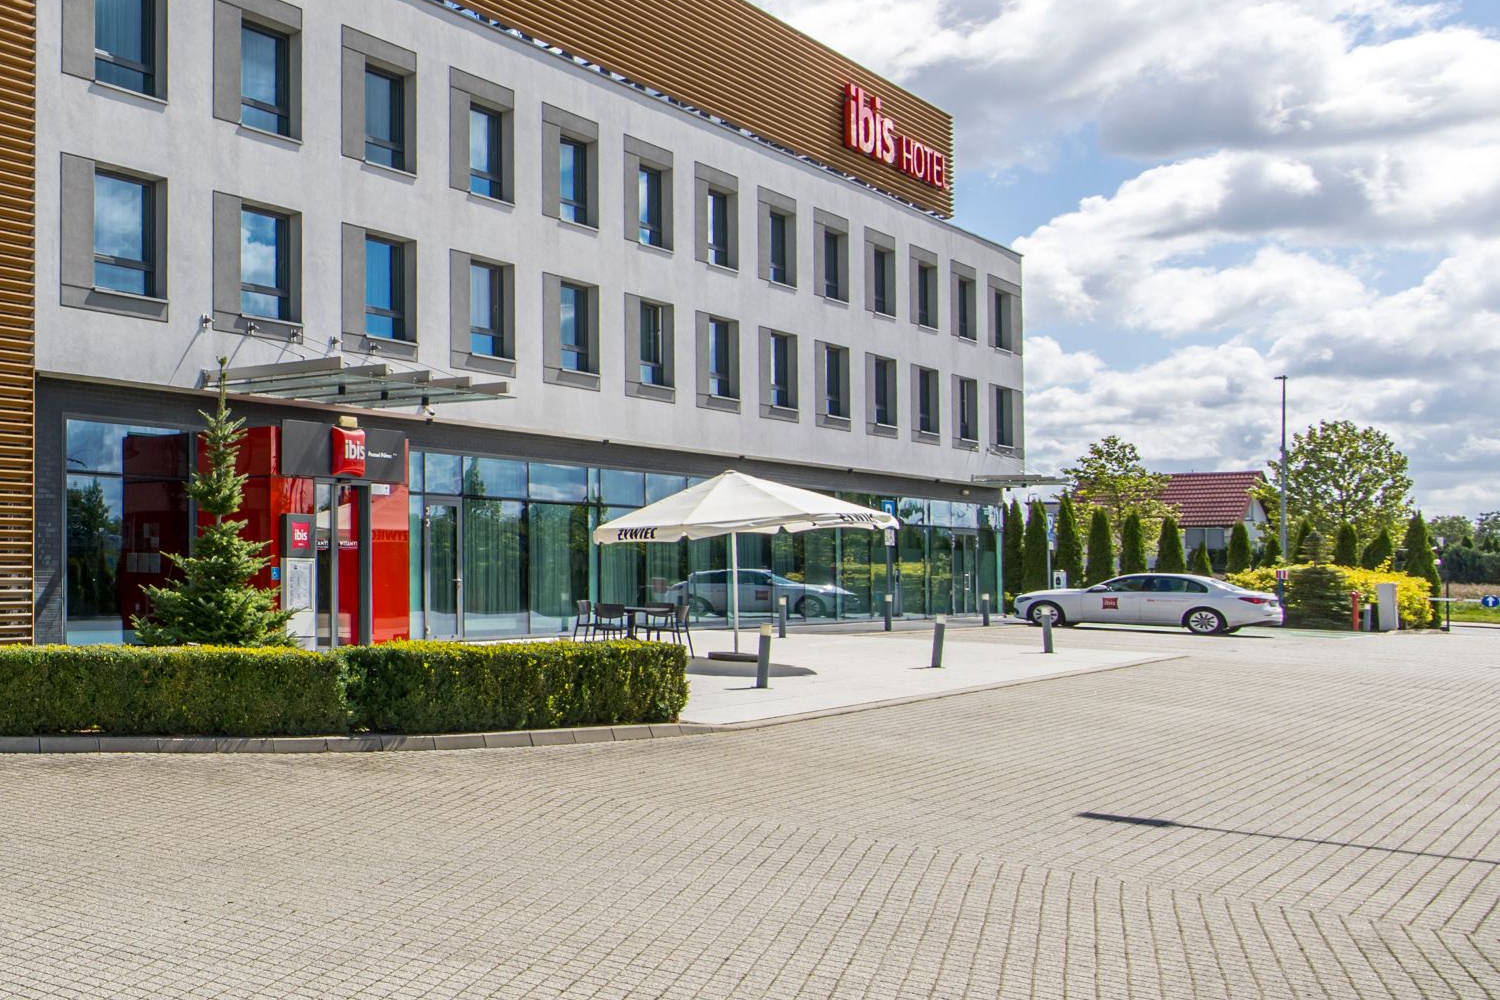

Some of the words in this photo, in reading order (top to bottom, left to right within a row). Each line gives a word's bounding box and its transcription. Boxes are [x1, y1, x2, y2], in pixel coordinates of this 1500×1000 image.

[847, 83, 895, 164] ibis
[901, 135, 950, 190] HOTEL
[345, 440, 365, 460] ibis
[295, 529, 307, 541] ibis
